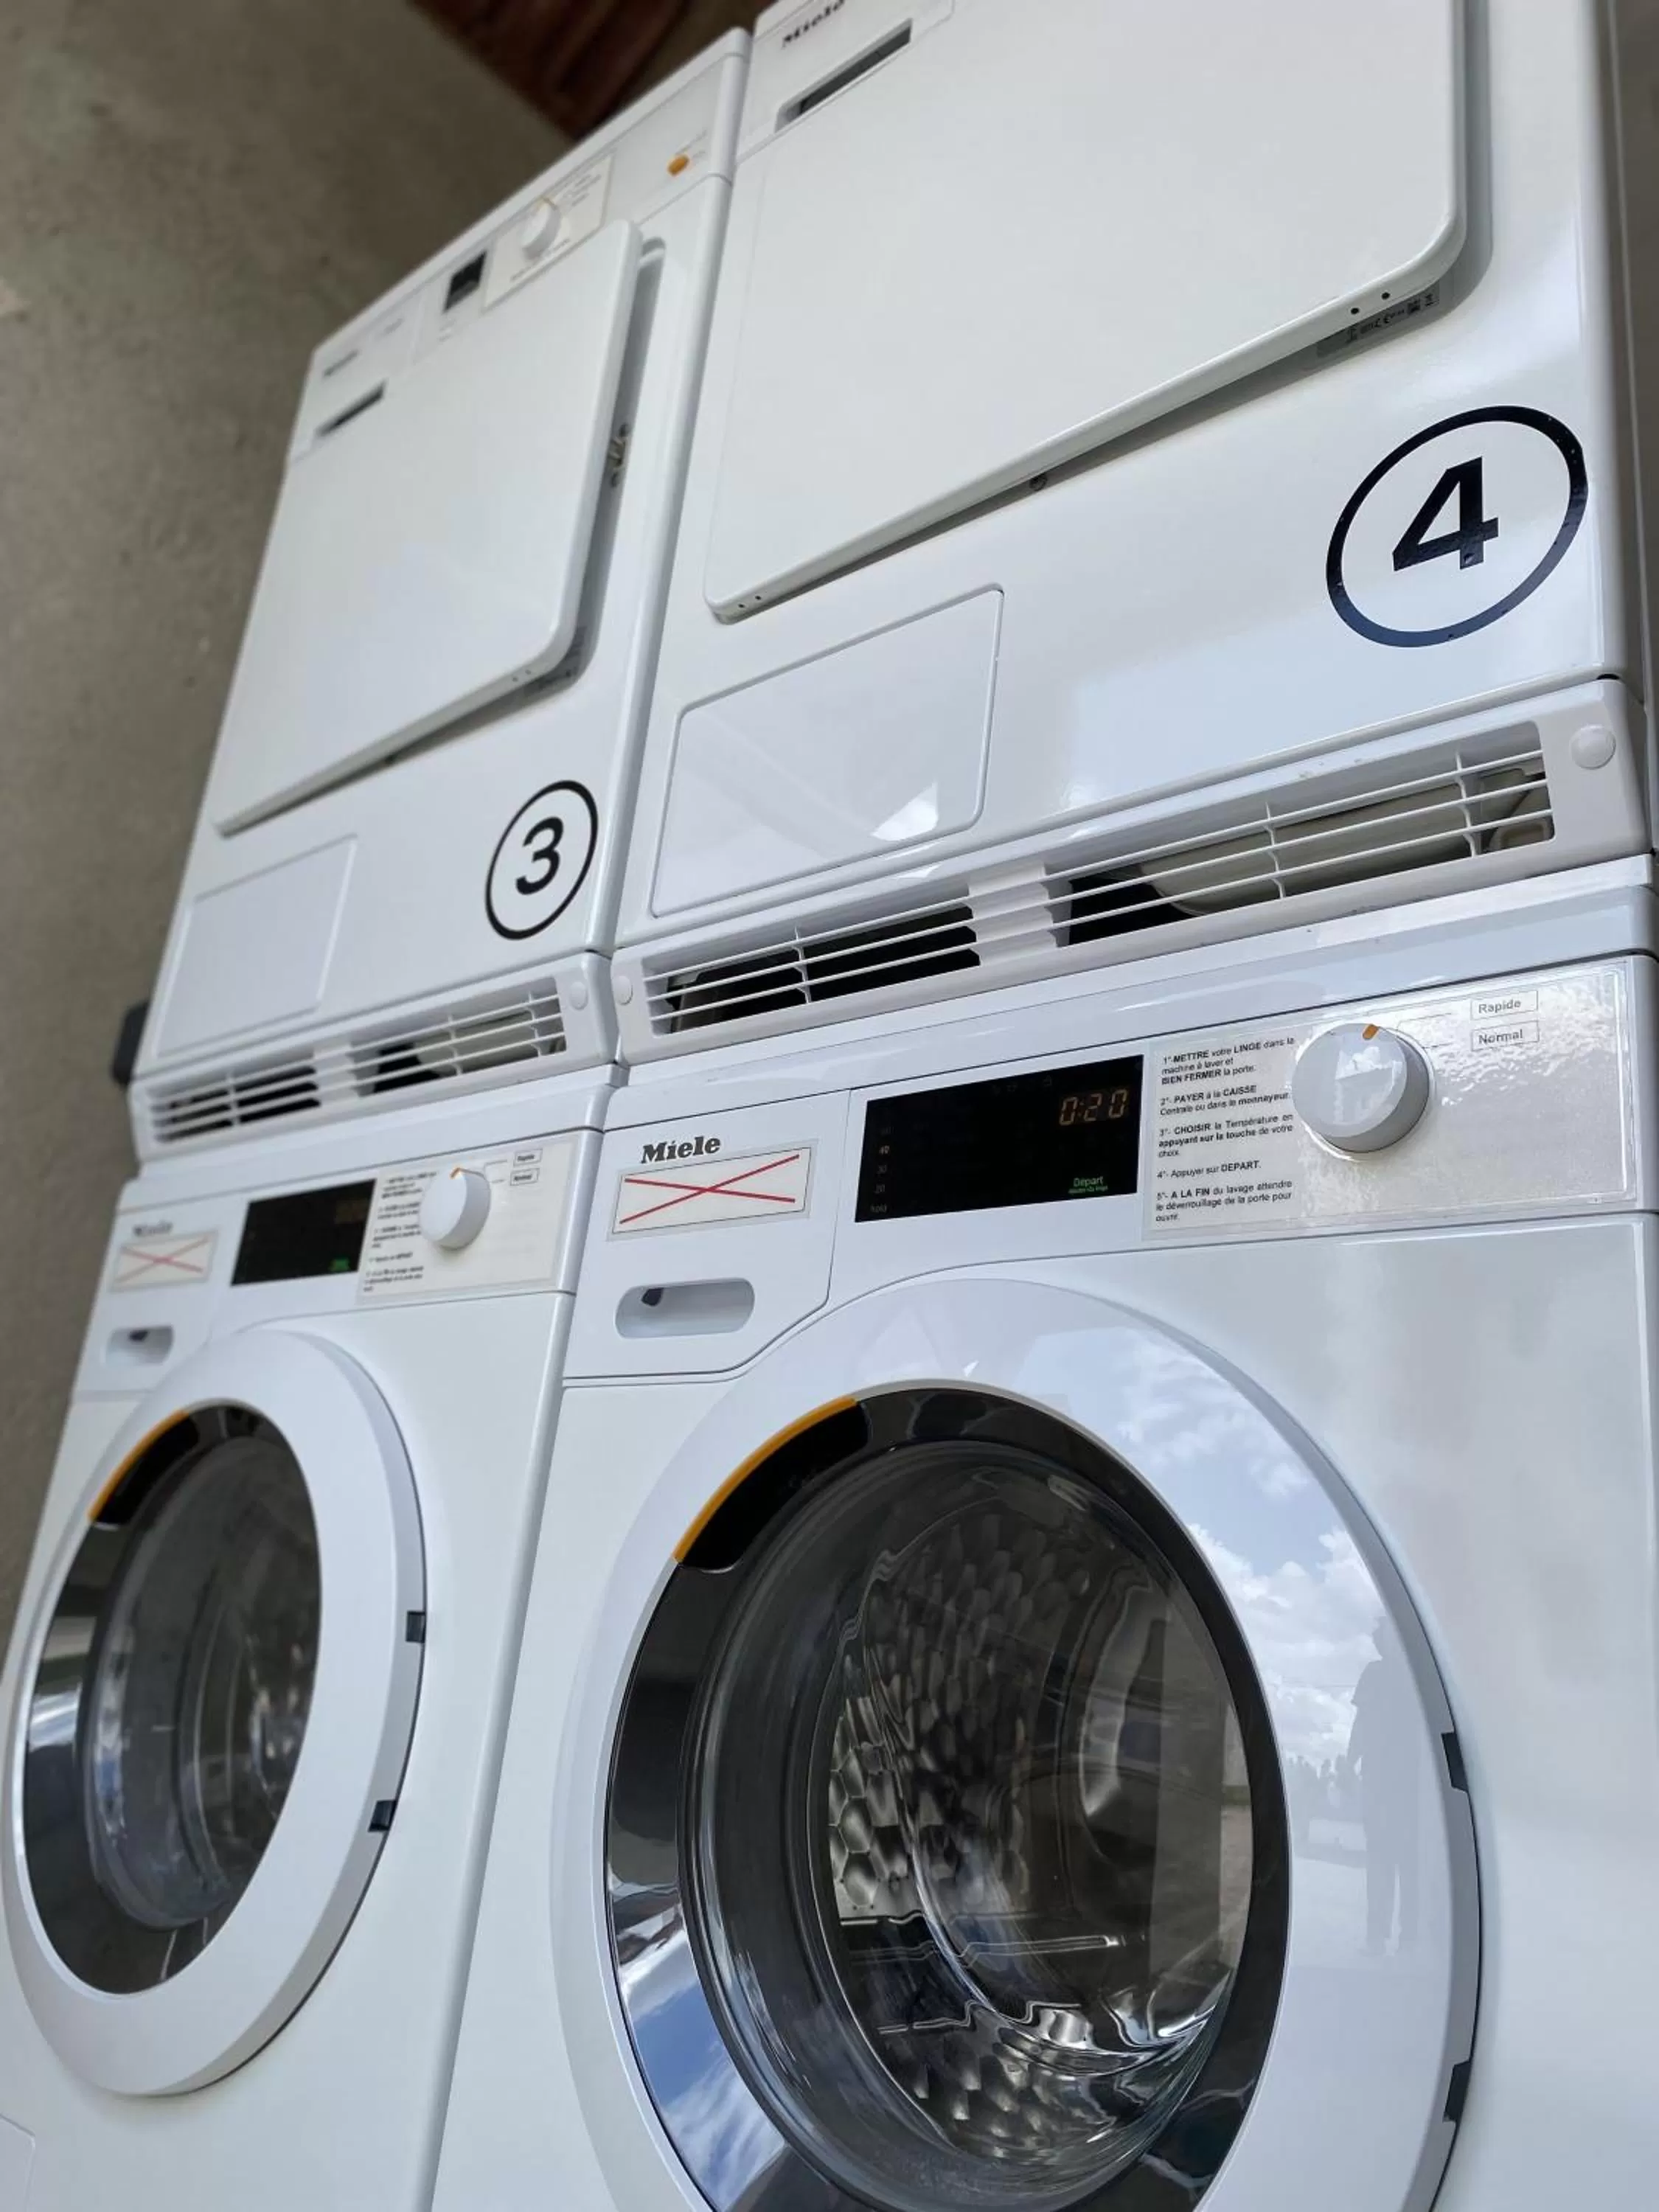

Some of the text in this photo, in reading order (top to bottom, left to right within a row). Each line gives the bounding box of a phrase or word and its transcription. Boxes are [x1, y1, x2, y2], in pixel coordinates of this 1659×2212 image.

[1392, 456, 1499, 572] 4
[515, 816, 564, 895] 3
[1478, 998, 1521, 1014] Rapide
[1478, 1029, 1523, 1044] Normal
[1234, 1042, 1262, 1054] LINGE
[1161, 1064, 1195, 1075] machine
[1204, 1059, 1224, 1068] laver
[1225, 1057, 1234, 1065] et
[1161, 1075, 1182, 1085] BIEN
[1183, 1068, 1222, 1082] FERMER
[1223, 1067, 1231, 1076] la
[1173, 1092, 1204, 1104] PAYER
[1222, 1085, 1256, 1096] CAISSE
[1058, 1088, 1129, 1127] 0:20
[1160, 1106, 1193, 1116] Centrale
[1206, 1101, 1227, 1110] dans
[1173, 1123, 1211, 1135] CHOISIR
[1214, 1121, 1222, 1130] la
[1225, 1116, 1279, 1129] Température
[1158, 1136, 1198, 1148] appuyant
[1216, 1132, 1223, 1141] la
[1226, 1128, 1256, 1139] touche
[1259, 1127, 1269, 1135] de
[1271, 1124, 1293, 1133] votre
[640, 1136, 721, 1164] Miele
[1170, 1168, 1204, 1178] Appuyer
[1206, 1166, 1219, 1175] sur
[1180, 1189, 1192, 1198] LA
[1195, 1187, 1210, 1197] FIN
[1226, 1185, 1254, 1194] lavage
[1256, 1180, 1293, 1191] attendre
[1247, 1193, 1270, 1204] porte
[1272, 1192, 1292, 1203] pour
